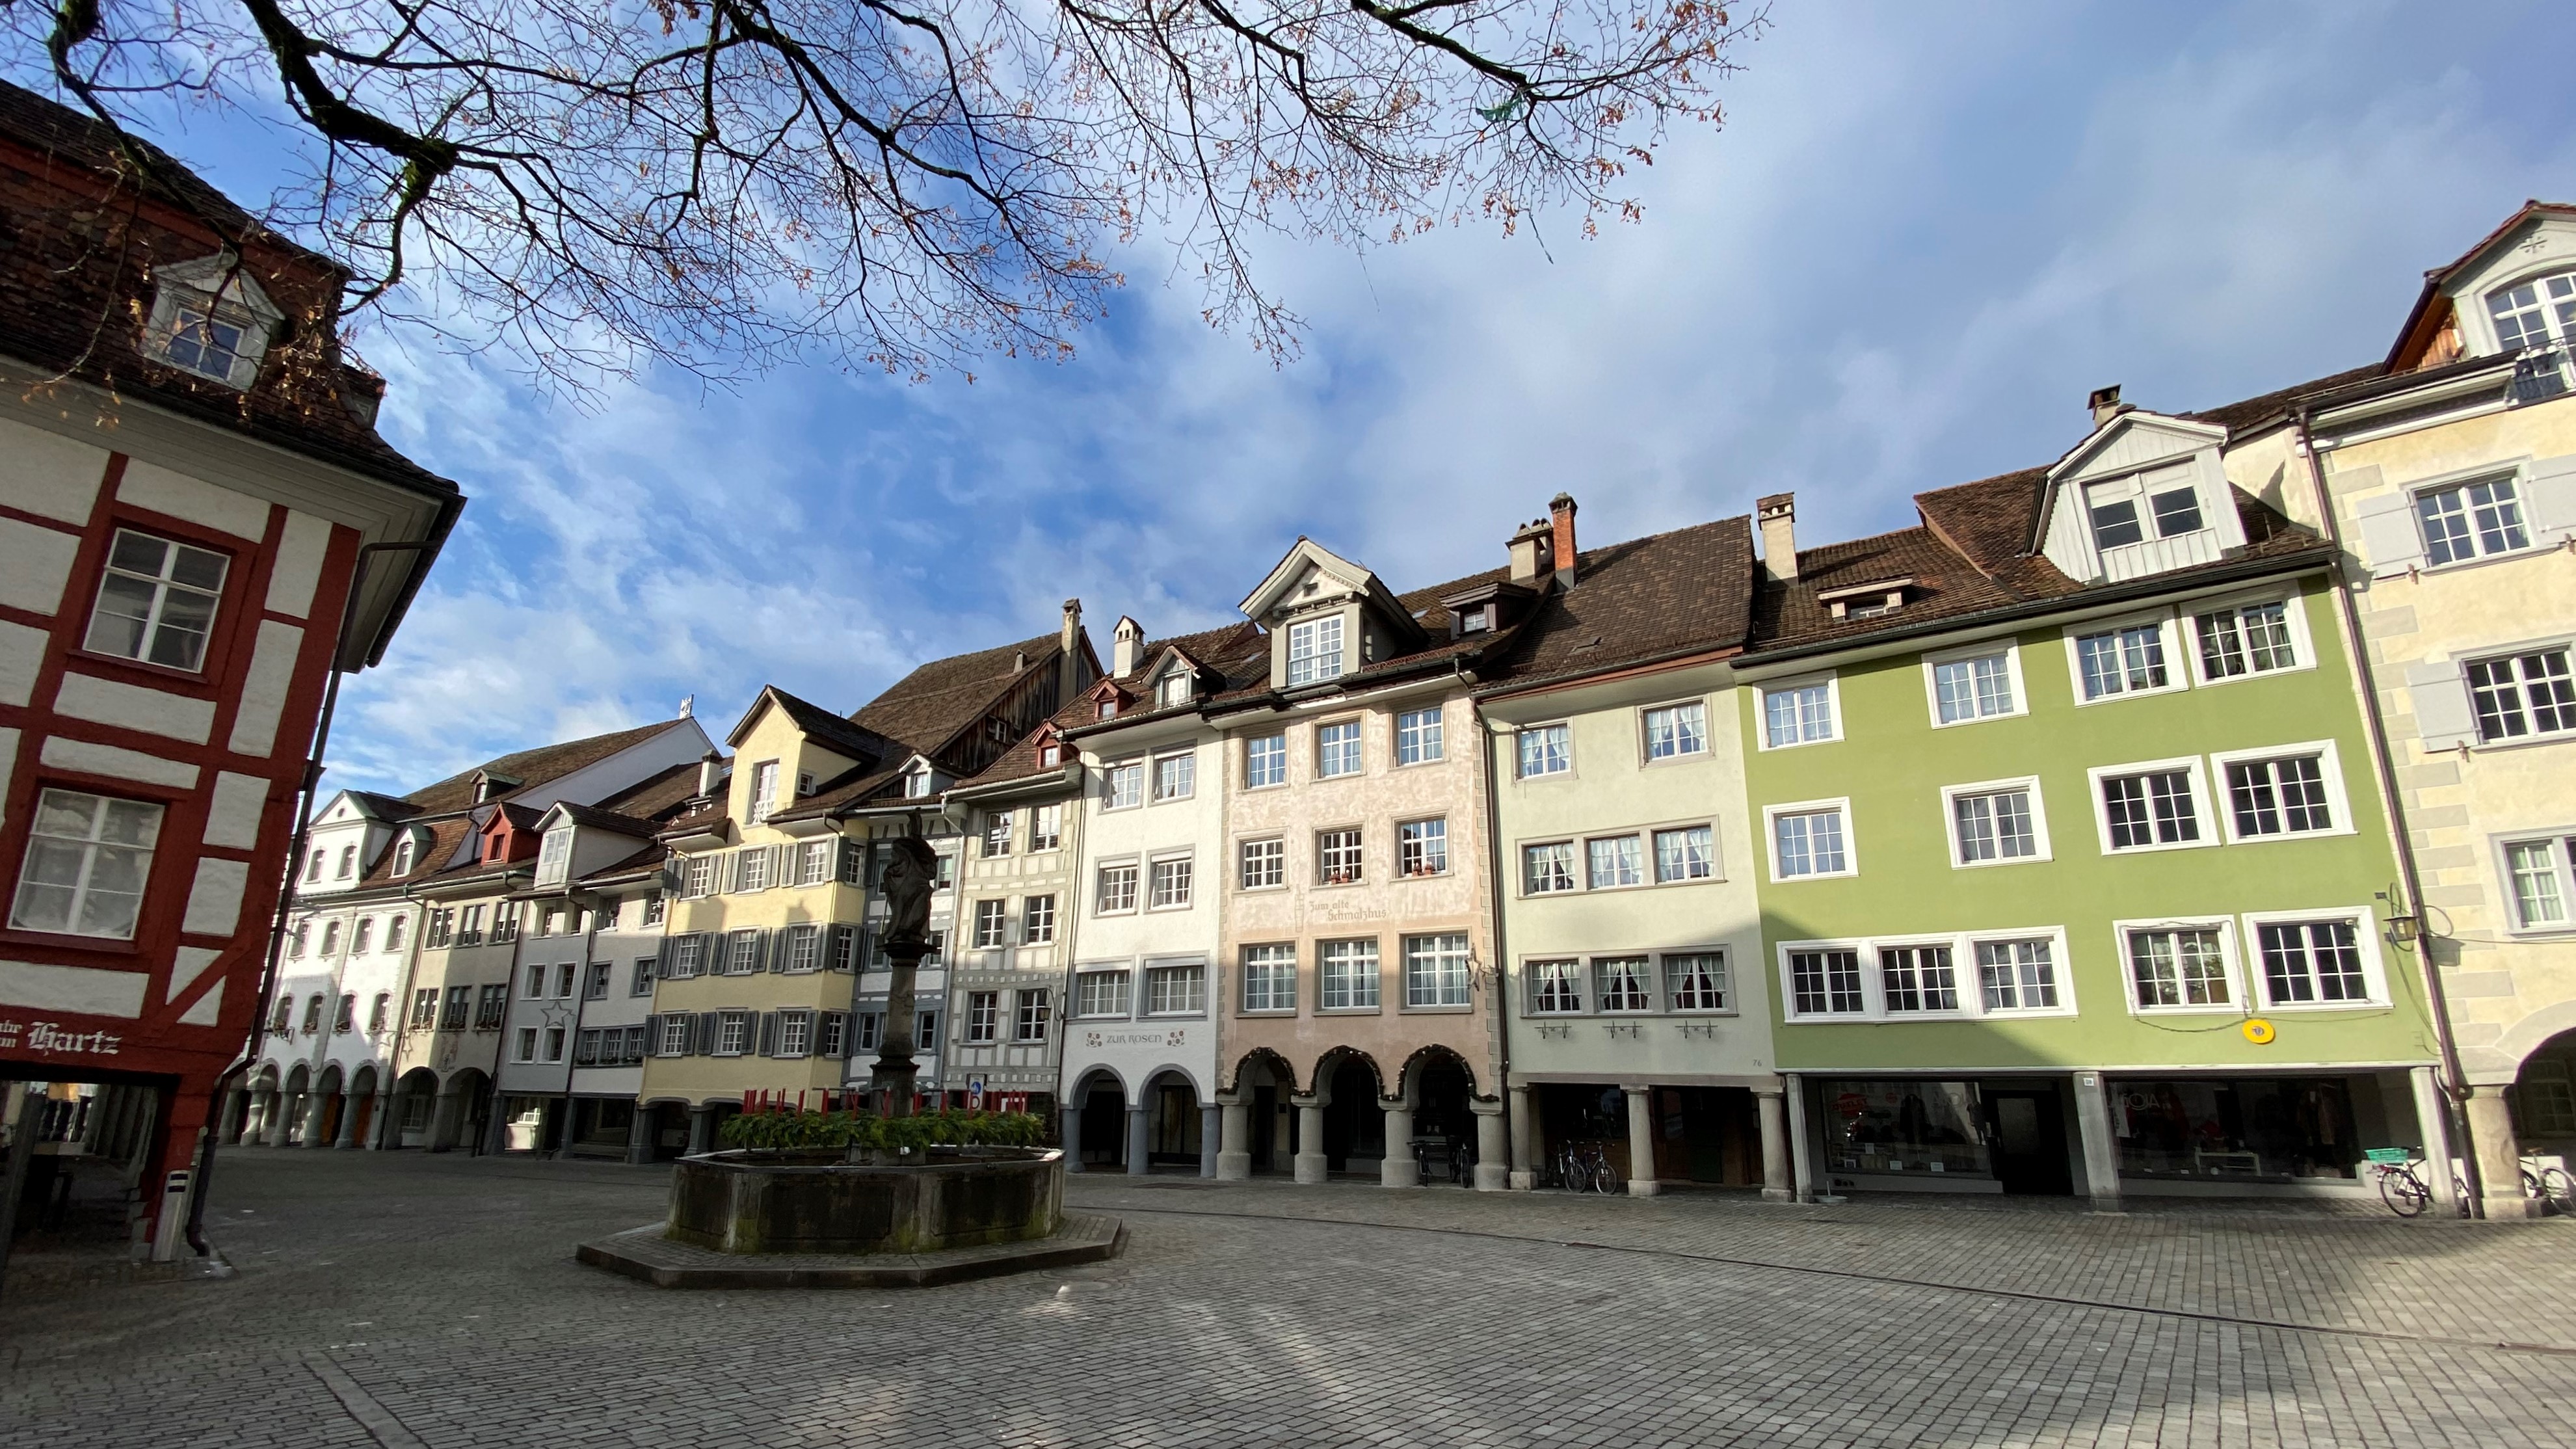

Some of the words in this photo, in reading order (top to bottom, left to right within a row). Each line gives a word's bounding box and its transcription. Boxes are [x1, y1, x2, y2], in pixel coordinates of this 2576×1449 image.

[27, 1021, 123, 1057] Hartz
[1106, 1035, 1126, 1044] ZUR
[1128, 1034, 1162, 1044] ROSEN
[1753, 1059, 1762, 1067] 76
